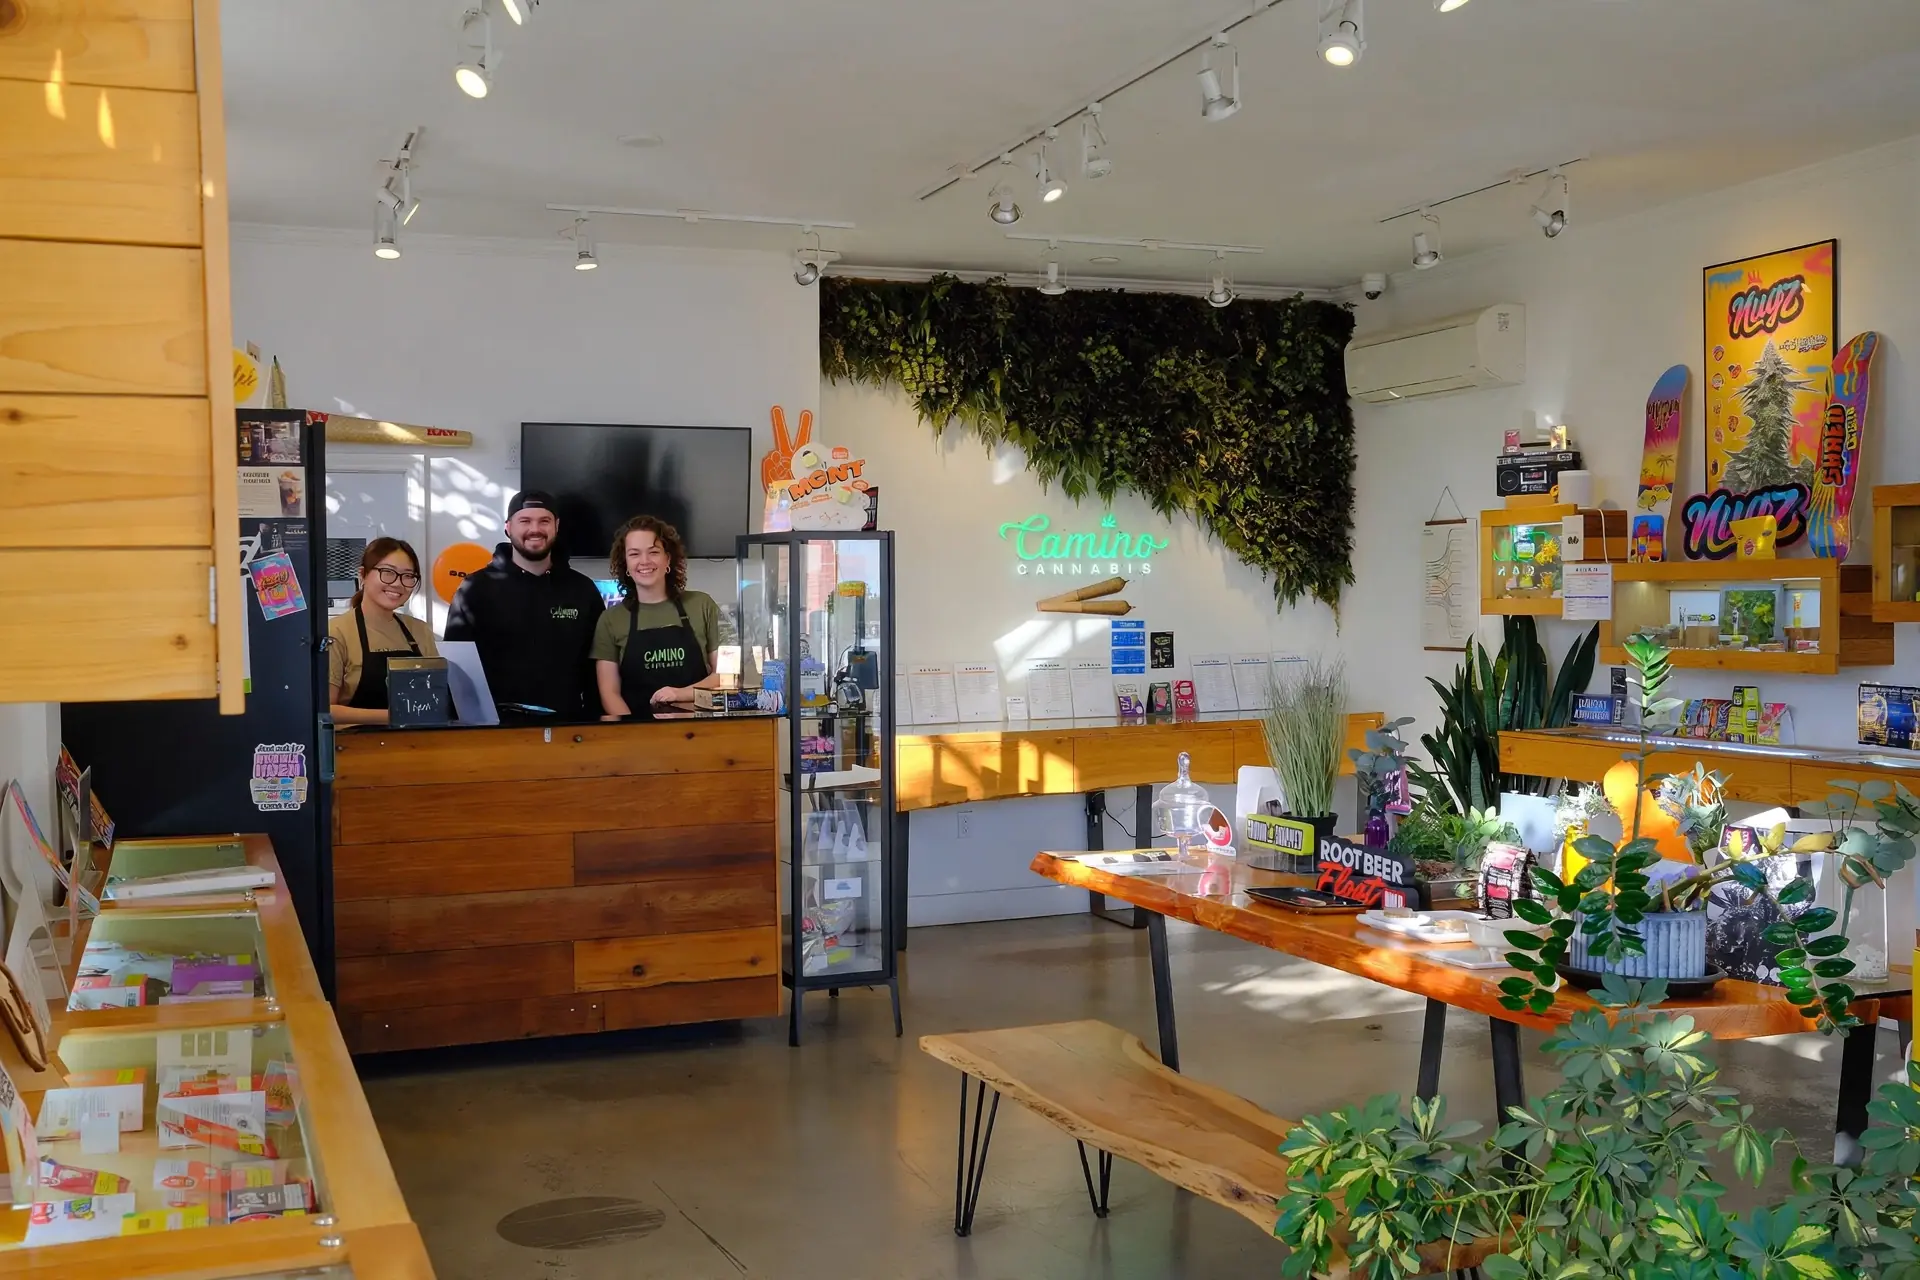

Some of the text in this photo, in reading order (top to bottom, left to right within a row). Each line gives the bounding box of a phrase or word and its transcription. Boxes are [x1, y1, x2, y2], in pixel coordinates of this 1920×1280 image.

[1730, 278, 1802, 337] Nugz
[999, 514, 1170, 560] Camino
[1017, 563, 1152, 576] CANNABIS
[644, 648, 685, 662] CAMINO
[1316, 861, 1388, 905] Float
[1320, 839, 1404, 885] ROOT BEER
